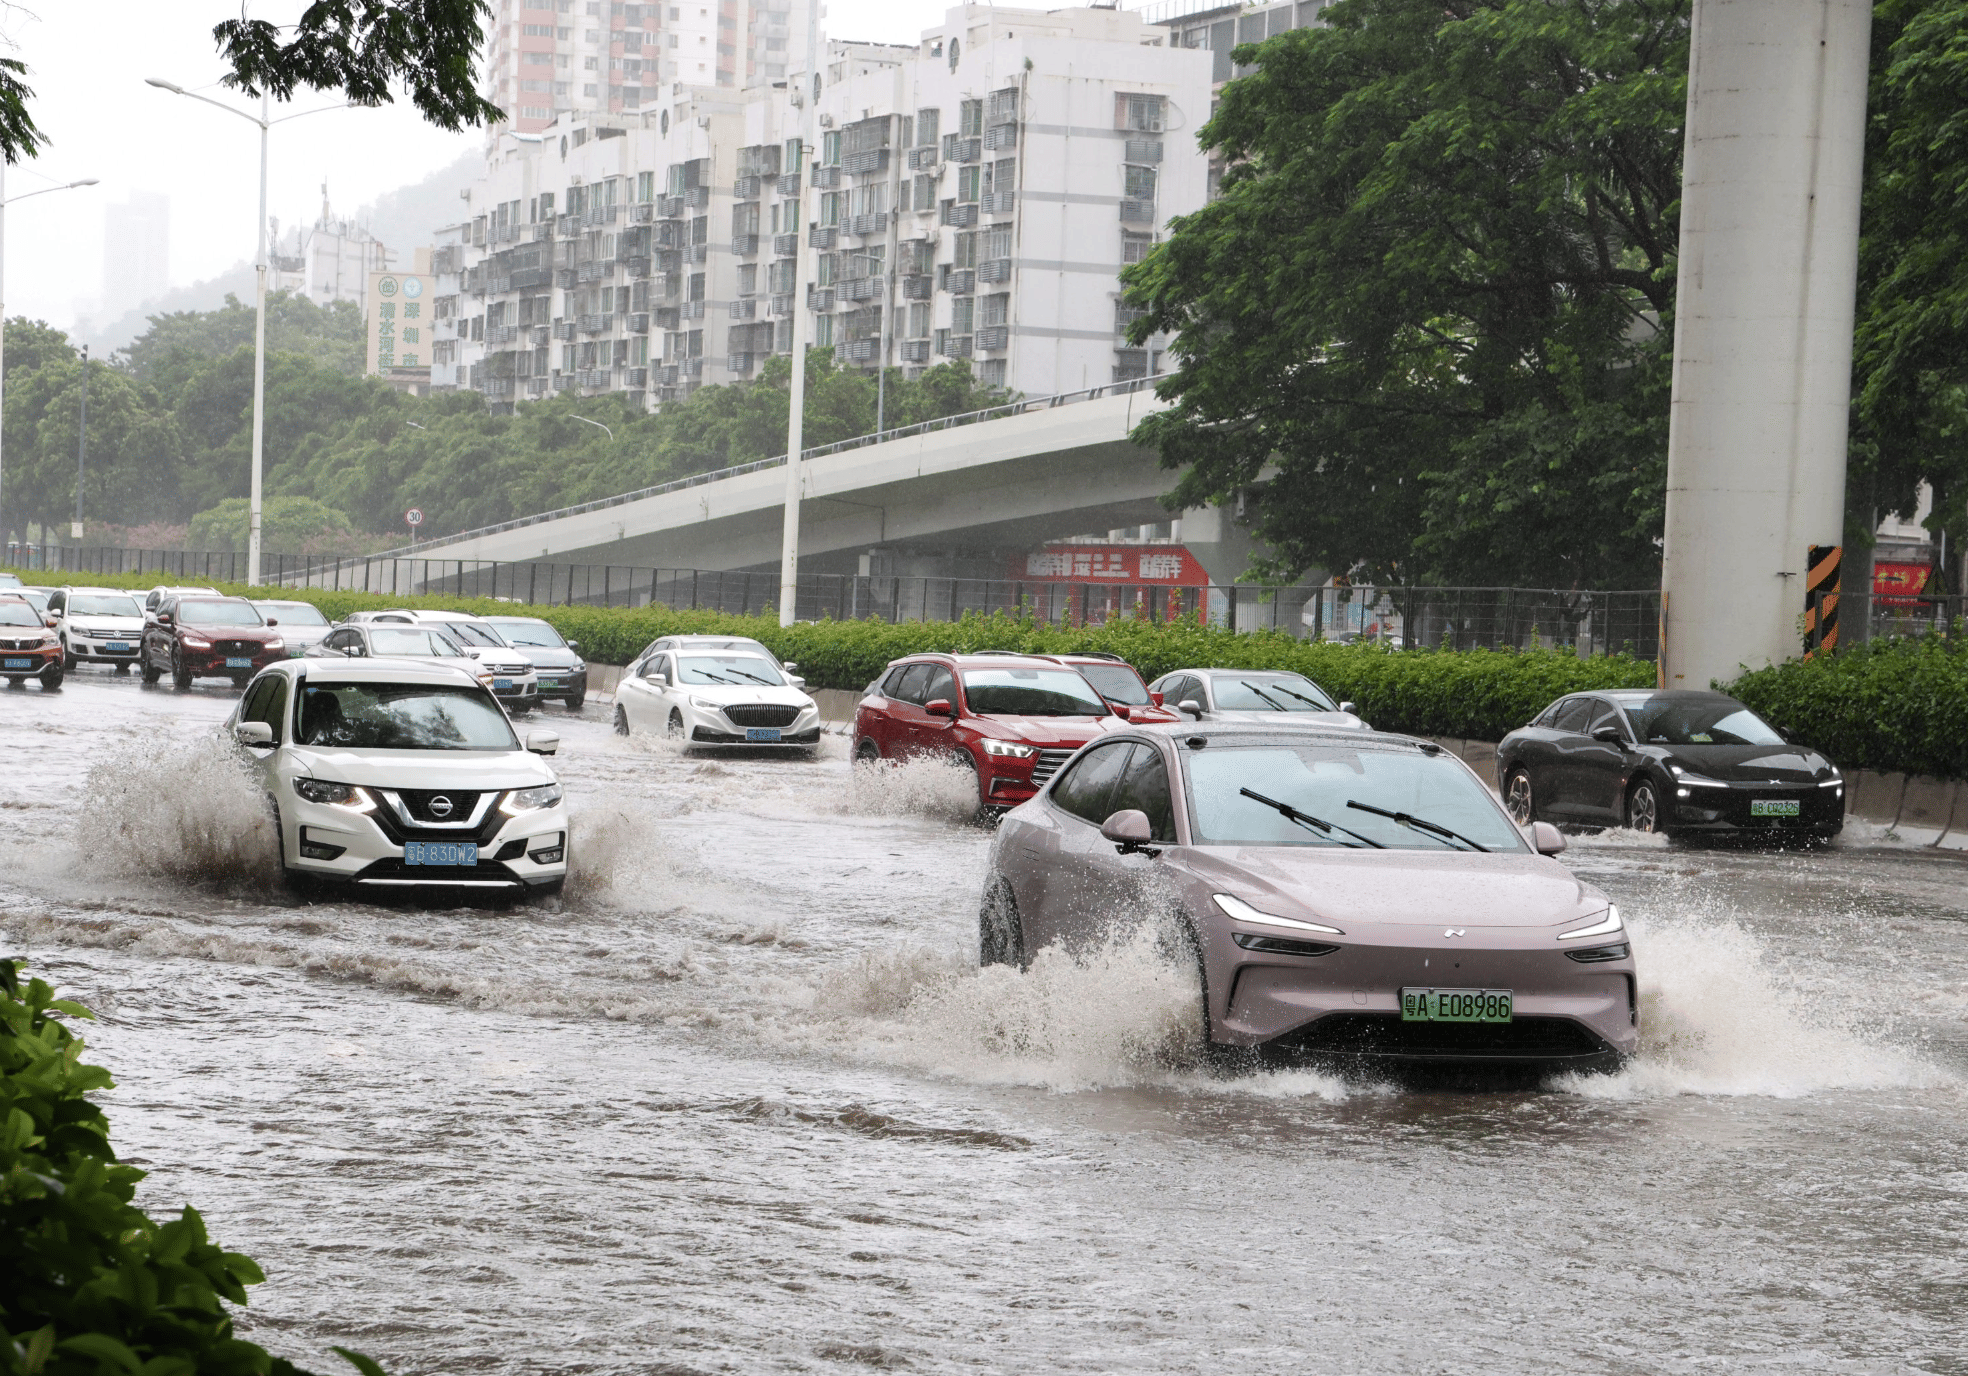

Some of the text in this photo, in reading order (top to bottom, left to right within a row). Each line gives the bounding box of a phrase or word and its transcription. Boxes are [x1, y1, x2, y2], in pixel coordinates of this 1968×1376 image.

[403, 302, 420, 366] 深圳市
[409, 511, 421, 522] 30
